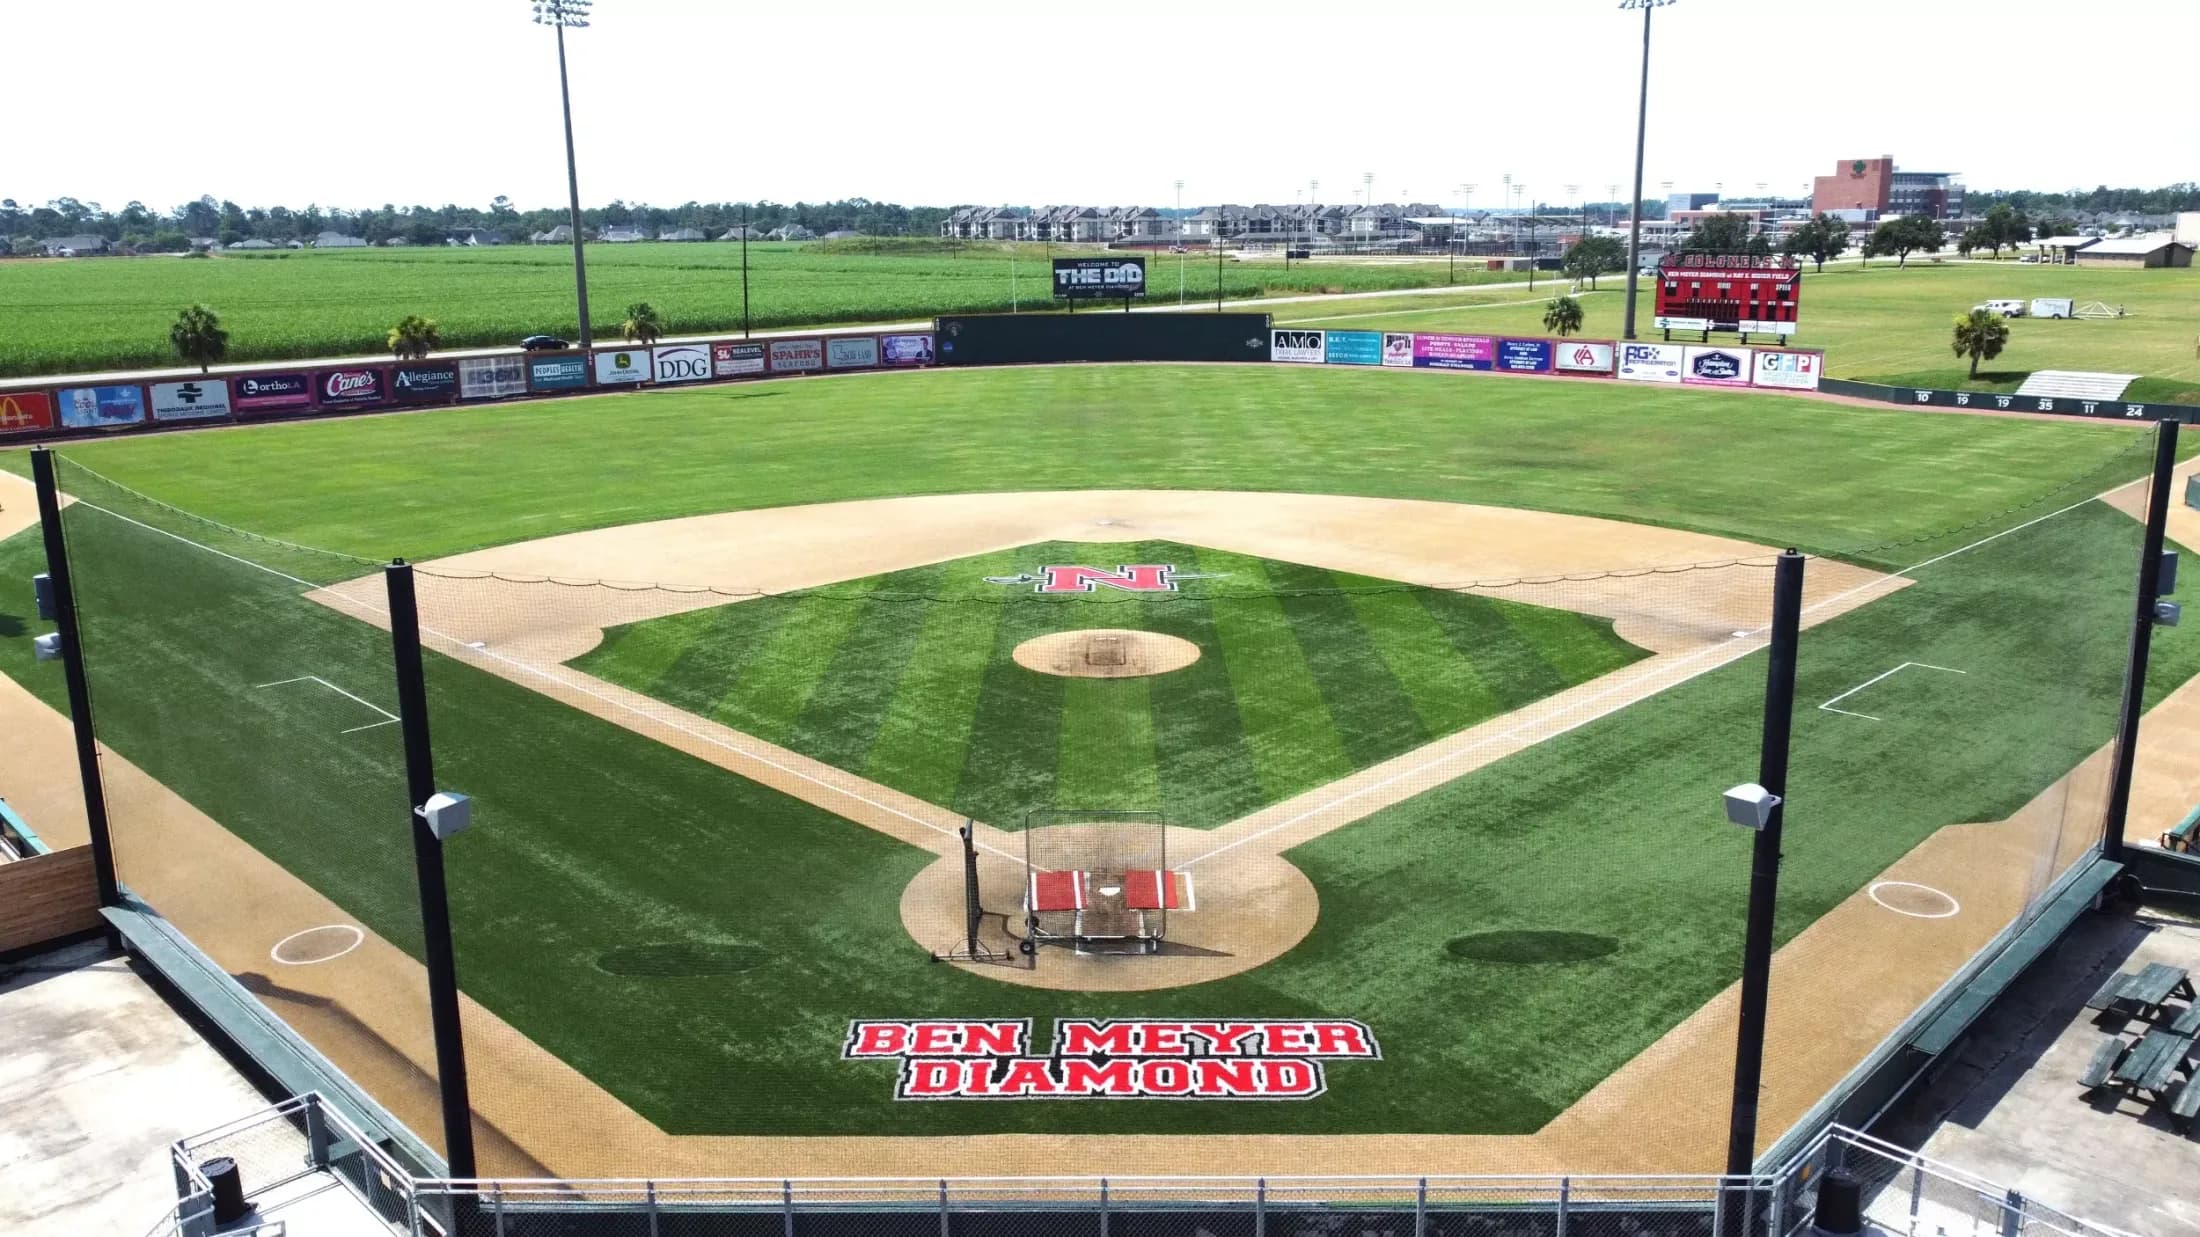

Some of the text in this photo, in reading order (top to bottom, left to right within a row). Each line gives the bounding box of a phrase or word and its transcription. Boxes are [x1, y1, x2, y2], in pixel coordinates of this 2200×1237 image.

[1685, 254, 1772, 269] COLONELS
[1055, 268, 1101, 284] THE
[1276, 335, 1321, 349] AMO
[659, 357, 708, 380] DDG
[326, 370, 377, 397] Cane's
[394, 370, 455, 388] Allegiance
[1917, 393, 1929, 402] 10
[1956, 396, 1969, 405] 19
[1997, 399, 2010, 408] 19
[2038, 401, 2054, 411] 35
[2084, 405, 2095, 414] 11
[2126, 407, 2143, 417] 24
[1035, 564, 1178, 593] N
[850, 1021, 1377, 1058] BEN MEYER
[900, 1057, 1326, 1099] DIAMOND
